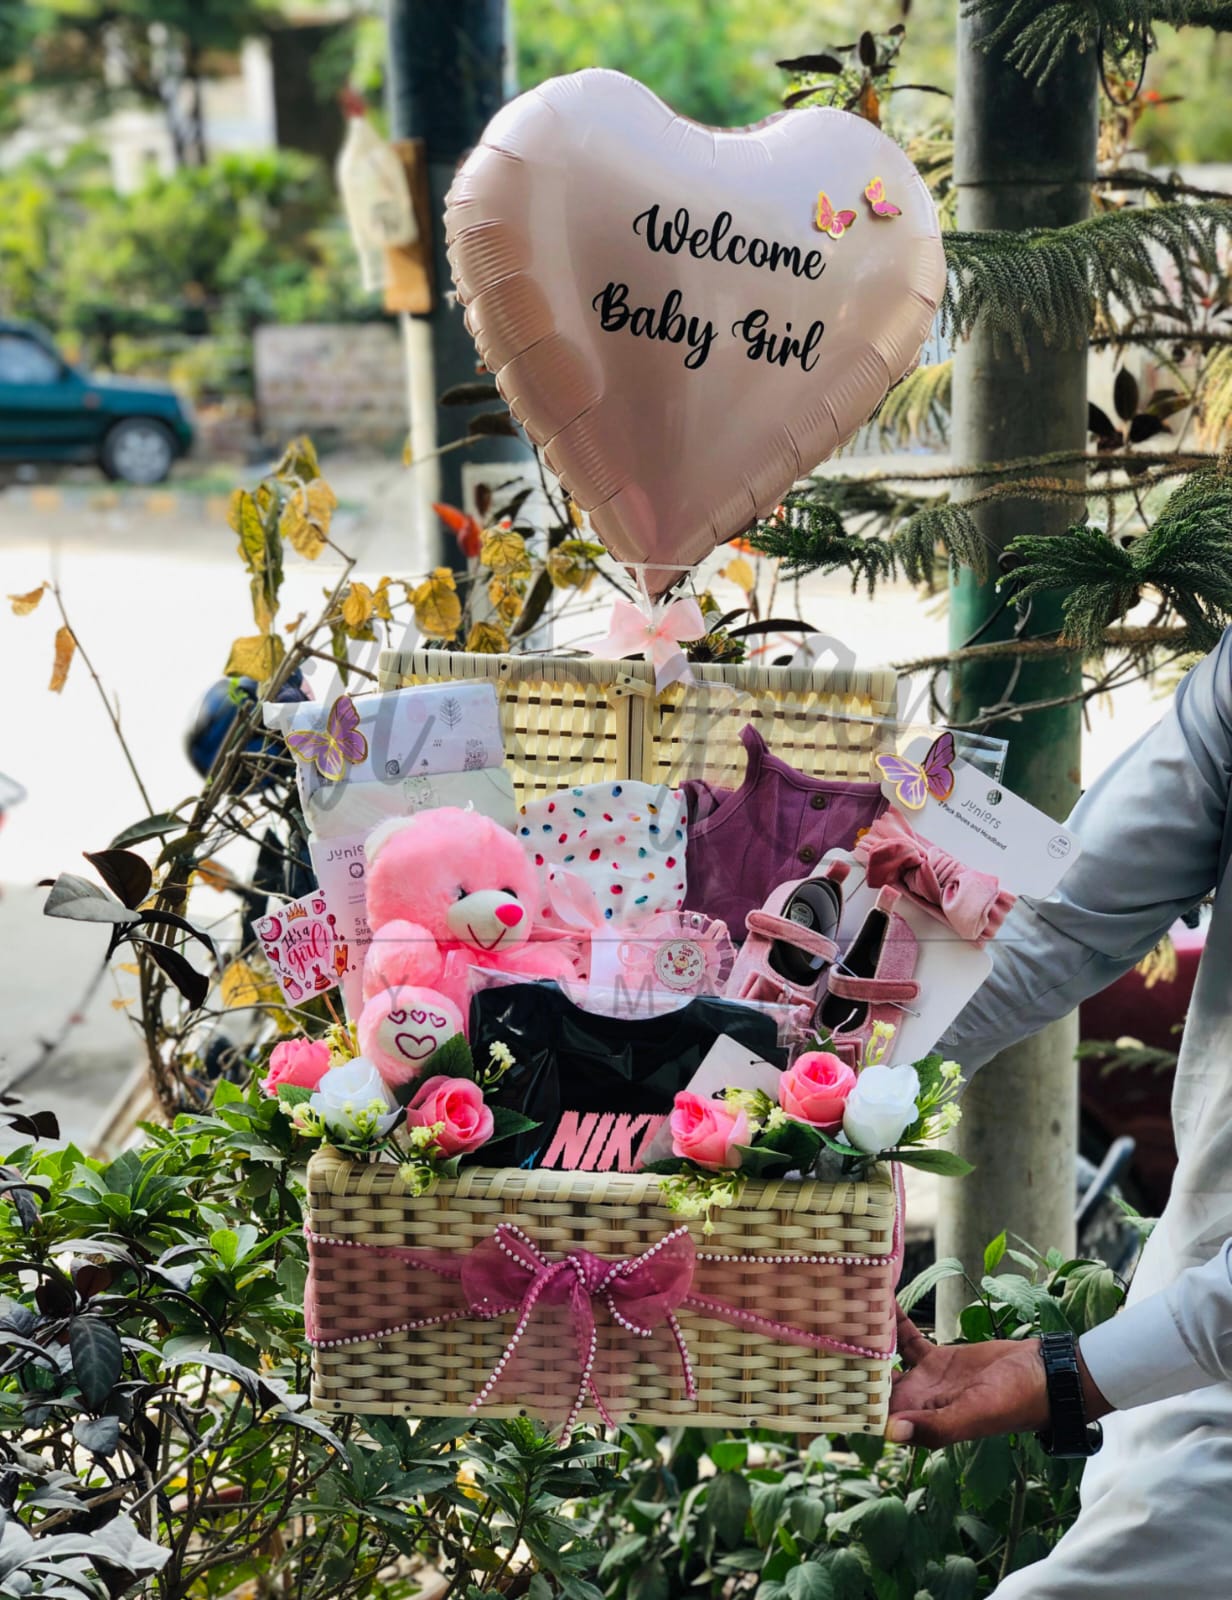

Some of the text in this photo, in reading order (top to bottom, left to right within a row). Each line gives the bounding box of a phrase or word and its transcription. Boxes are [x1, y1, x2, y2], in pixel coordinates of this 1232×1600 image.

[632, 204, 826, 280] Welcome
[592, 282, 825, 372] Baby Girl
[955, 812, 971, 827] Shoes
[970, 823, 982, 834] and
[980, 828, 1008, 851] Headband
[961, 799, 1001, 829] Juniors
[326, 844, 365, 862] Junio
[281, 926, 311, 952] It's a
[288, 922, 329, 981] girl!
